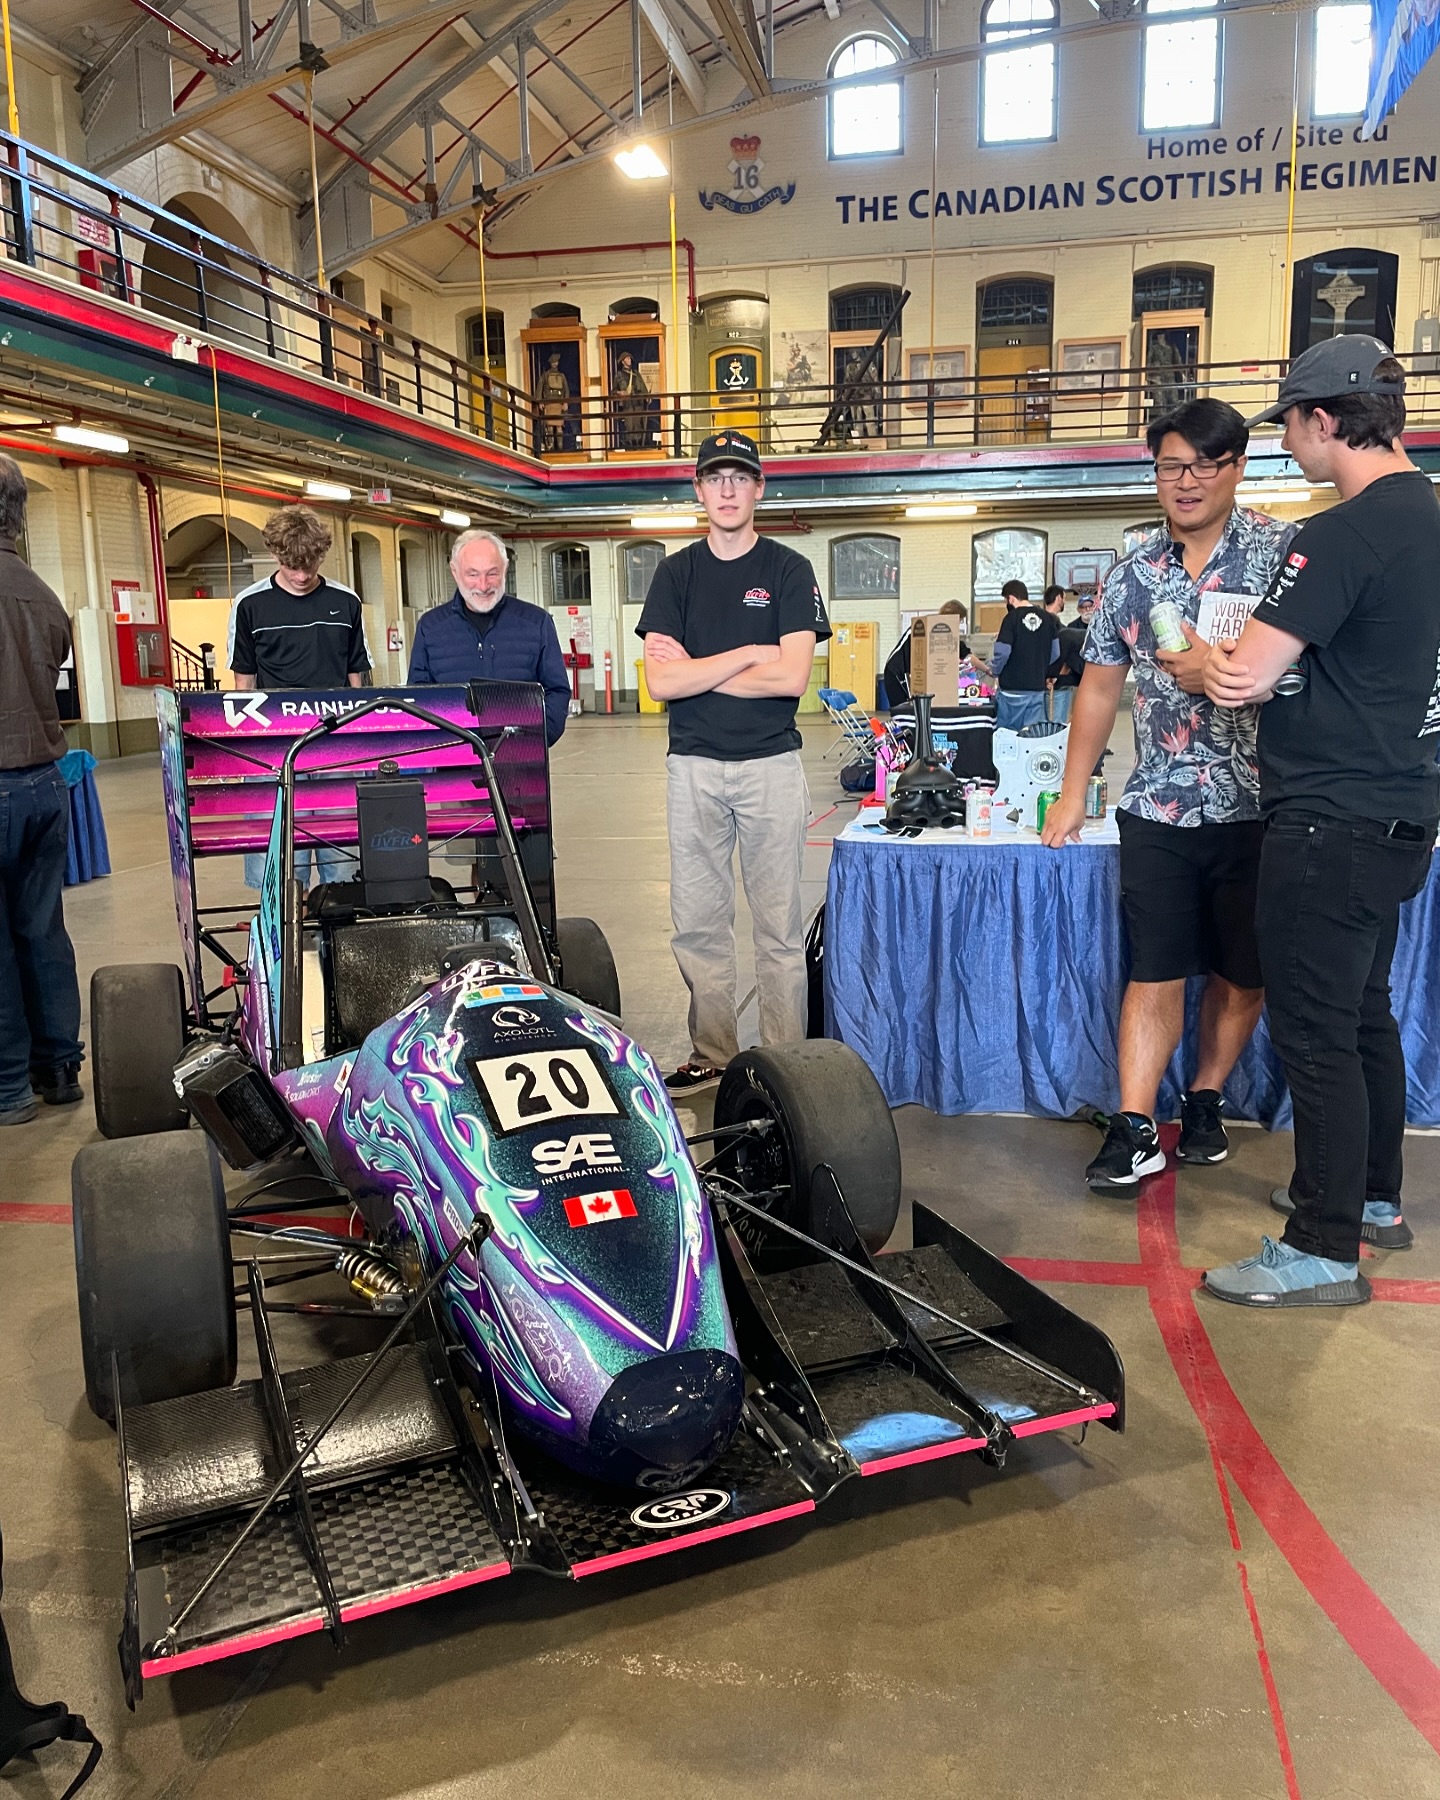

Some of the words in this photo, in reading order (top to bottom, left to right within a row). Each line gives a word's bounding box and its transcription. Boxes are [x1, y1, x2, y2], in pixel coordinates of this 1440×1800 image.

[1147, 136, 1228, 160] Home
[1236, 127, 1265, 152] of
[1271, 126, 1283, 152] /
[1295, 124, 1344, 149] Site
[733, 164, 759, 190] 16
[714, 194, 736, 211] DEAS
[740, 205, 753, 213] GU
[758, 189, 780, 208] CATH
[835, 194, 899, 224] THE
[908, 181, 1085, 219] CANADIAN
[1095, 167, 1263, 206] SCOTTISH
[1274, 155, 1438, 193] REGIMEN
[1215, 601, 1256, 619] WORK
[1210, 618, 1248, 637] HAR
[281, 697, 416, 716] RAINH
[493, 1027, 556, 1039] AXOLOTL
[505, 1057, 590, 1118] 20
[531, 1133, 623, 1174] SAE
[540, 1165, 627, 1186] INTERNATIONAL
[650, 1494, 707, 1518] CRP
